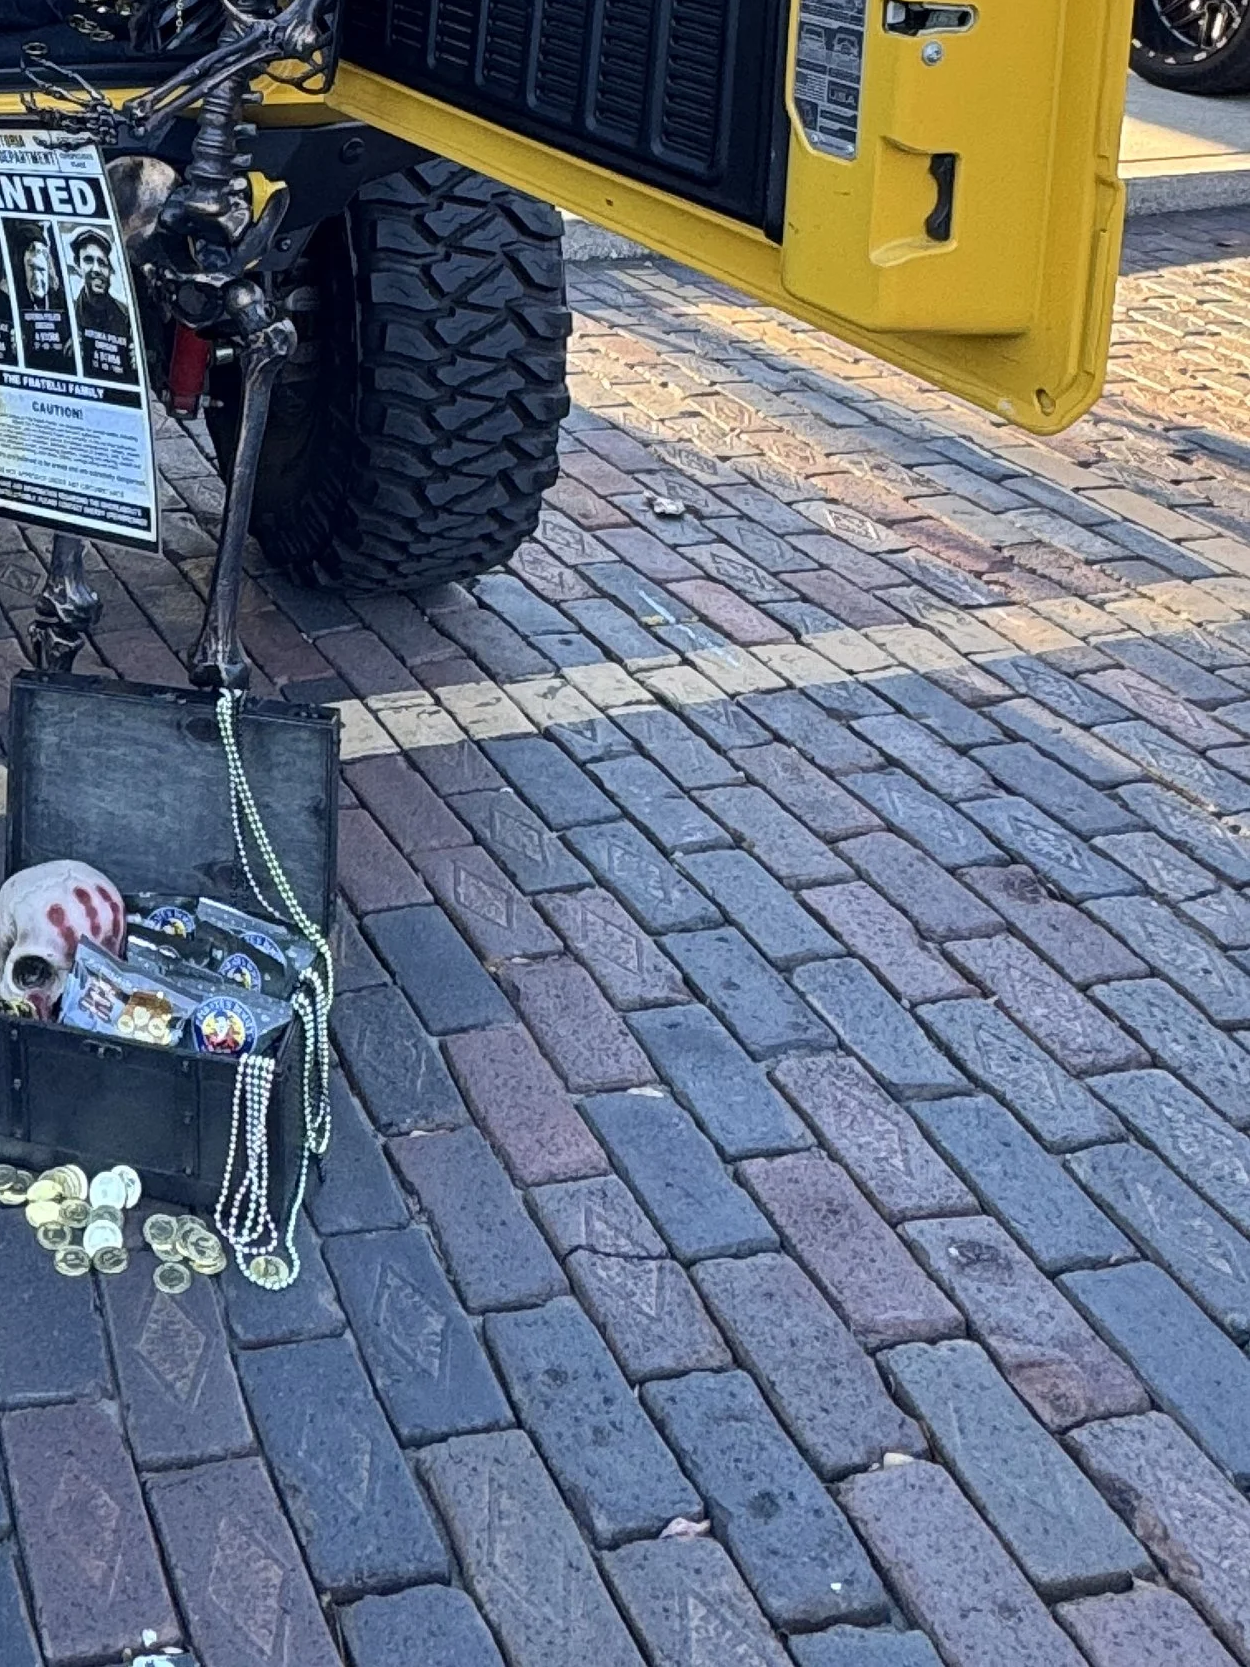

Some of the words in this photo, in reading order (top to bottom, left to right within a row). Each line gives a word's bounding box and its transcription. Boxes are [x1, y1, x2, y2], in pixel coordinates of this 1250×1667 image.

[0, 149, 56, 166] DEPARTMENT
[2, 372, 21, 385] THE
[23, 376, 67, 393] FRATELLI
[68, 383, 105, 399] FAMILY
[32, 400, 84, 420] CAUTION!
